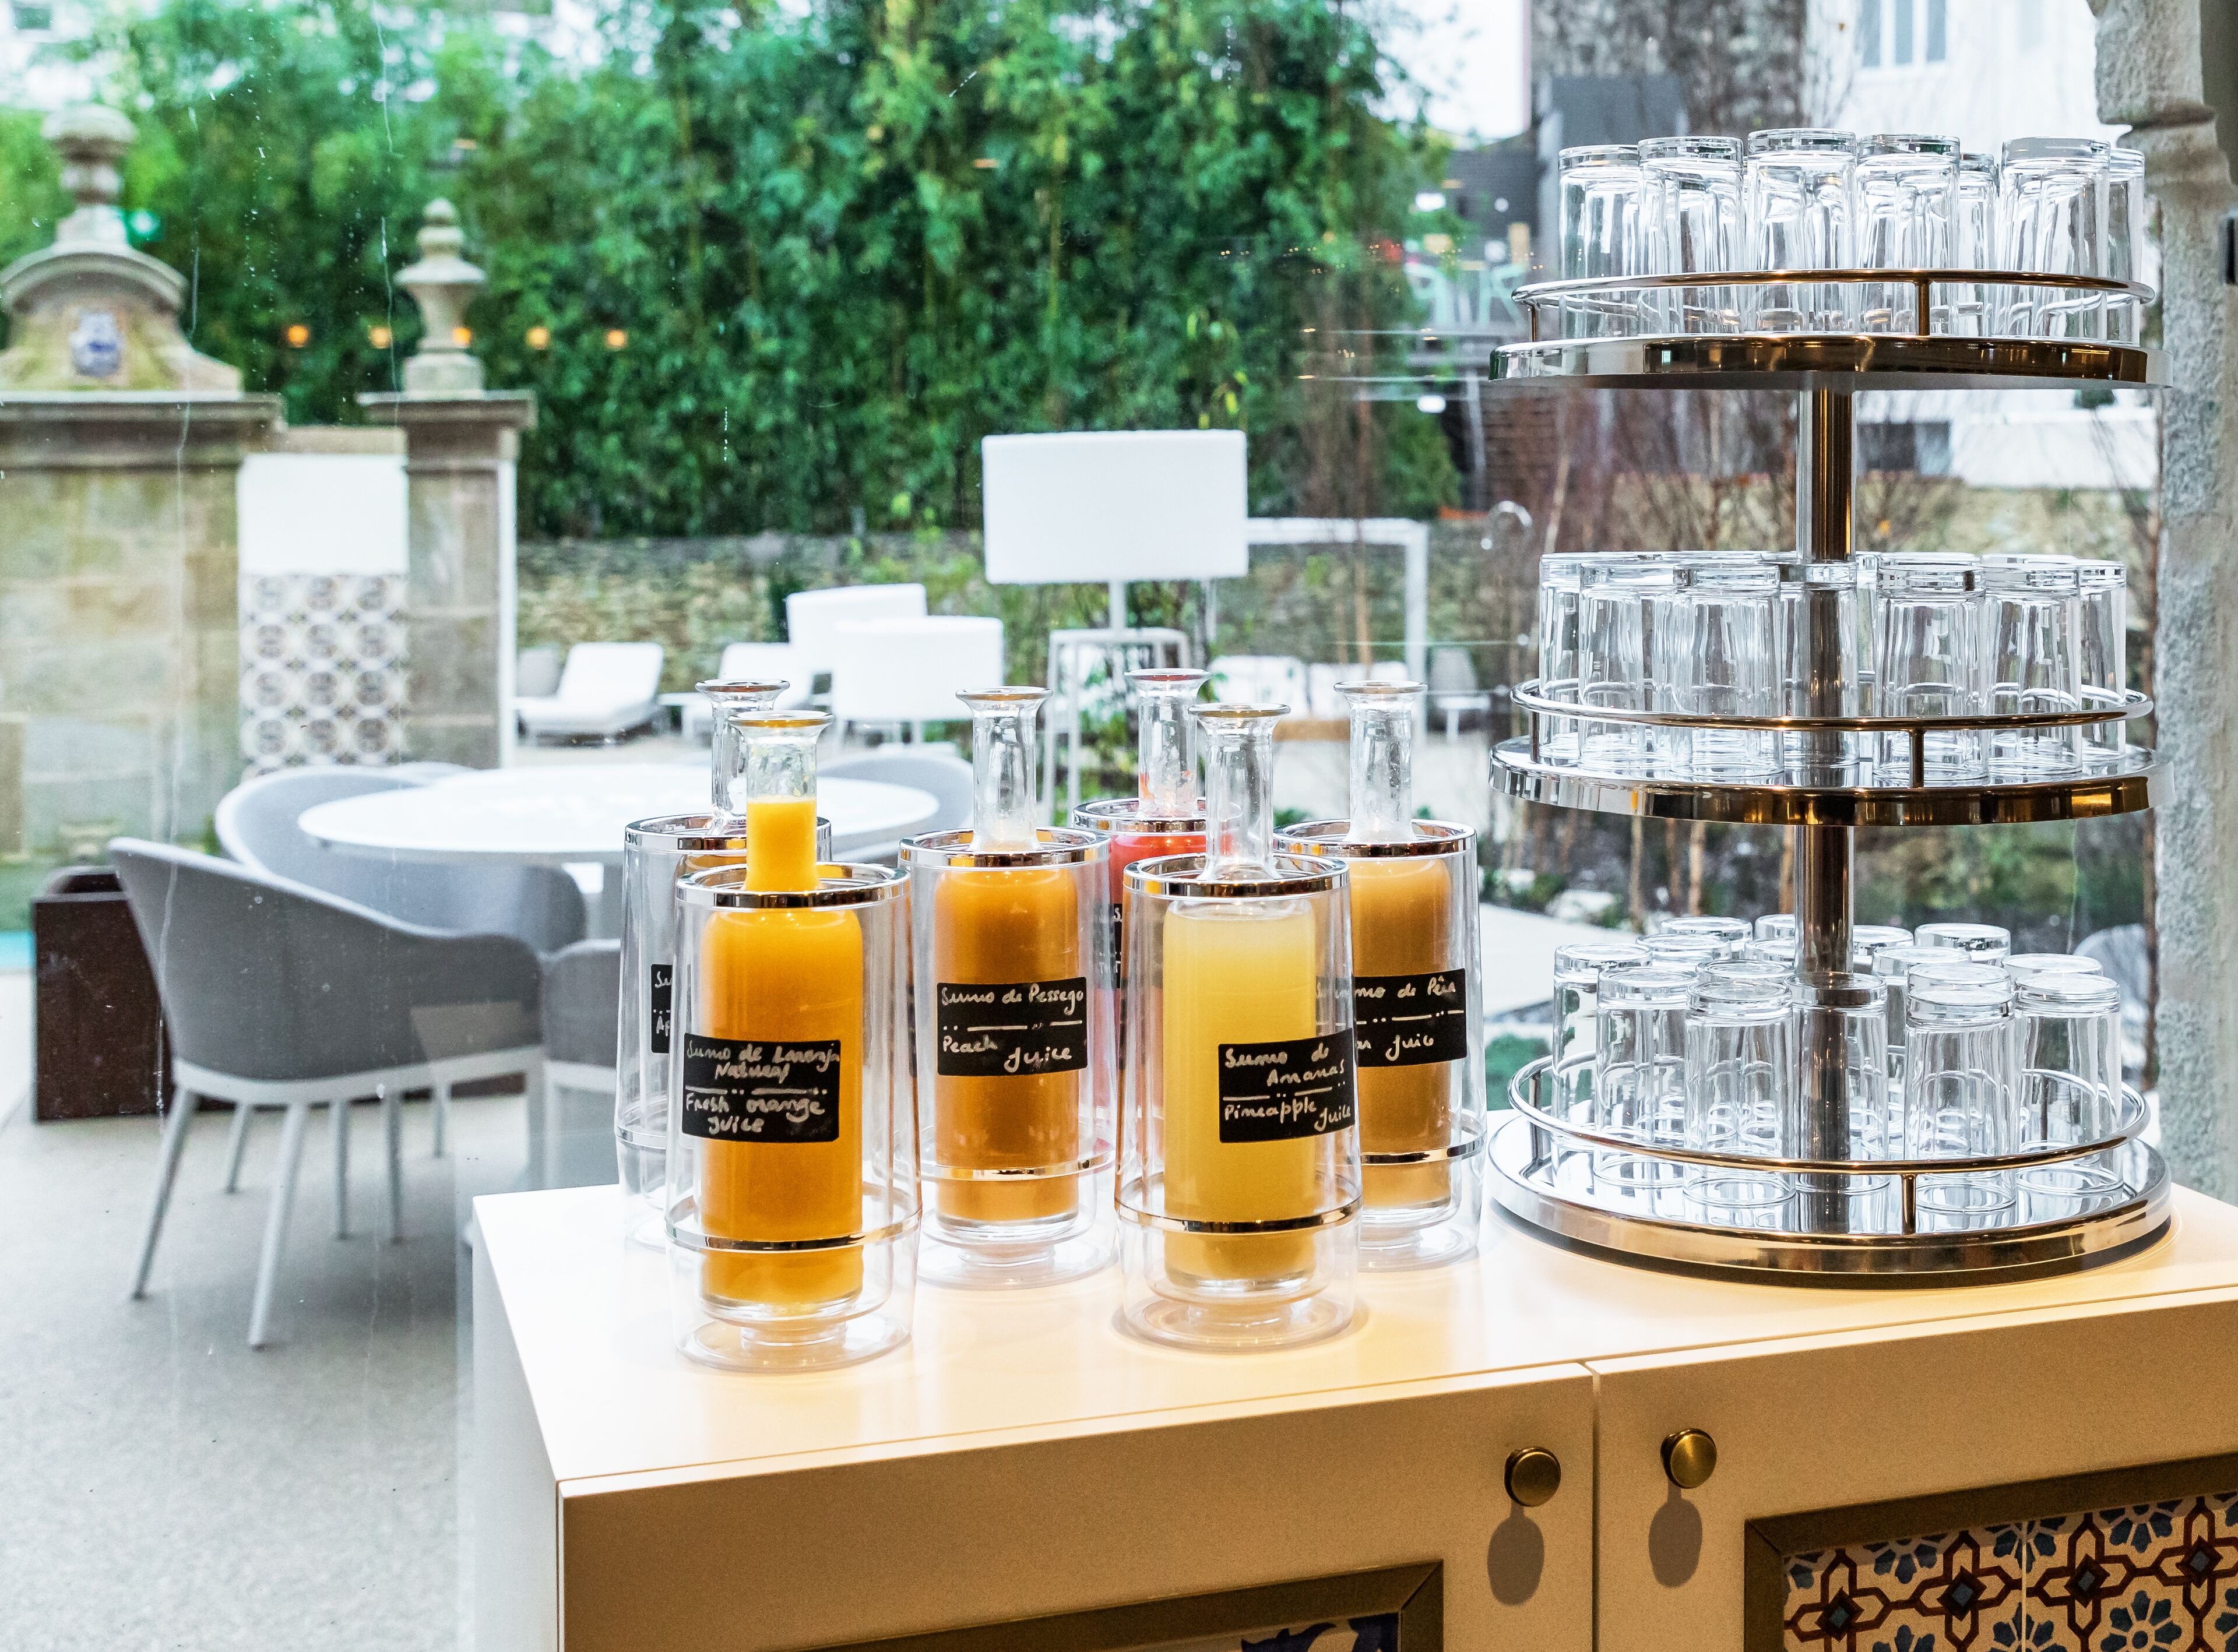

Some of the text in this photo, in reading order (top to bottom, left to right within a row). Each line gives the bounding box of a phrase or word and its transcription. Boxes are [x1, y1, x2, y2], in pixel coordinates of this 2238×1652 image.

[941, 987, 995, 1006] Sumo
[1002, 988, 1022, 1004] de
[687, 1040, 731, 1061] Sumo
[738, 1043, 763, 1063] de
[943, 1034, 998, 1053] Peach
[1224, 1042, 1329, 1069] Sumo de
[686, 1092, 826, 1123] Fresh orange
[1224, 1096, 1317, 1124] Pineapple
